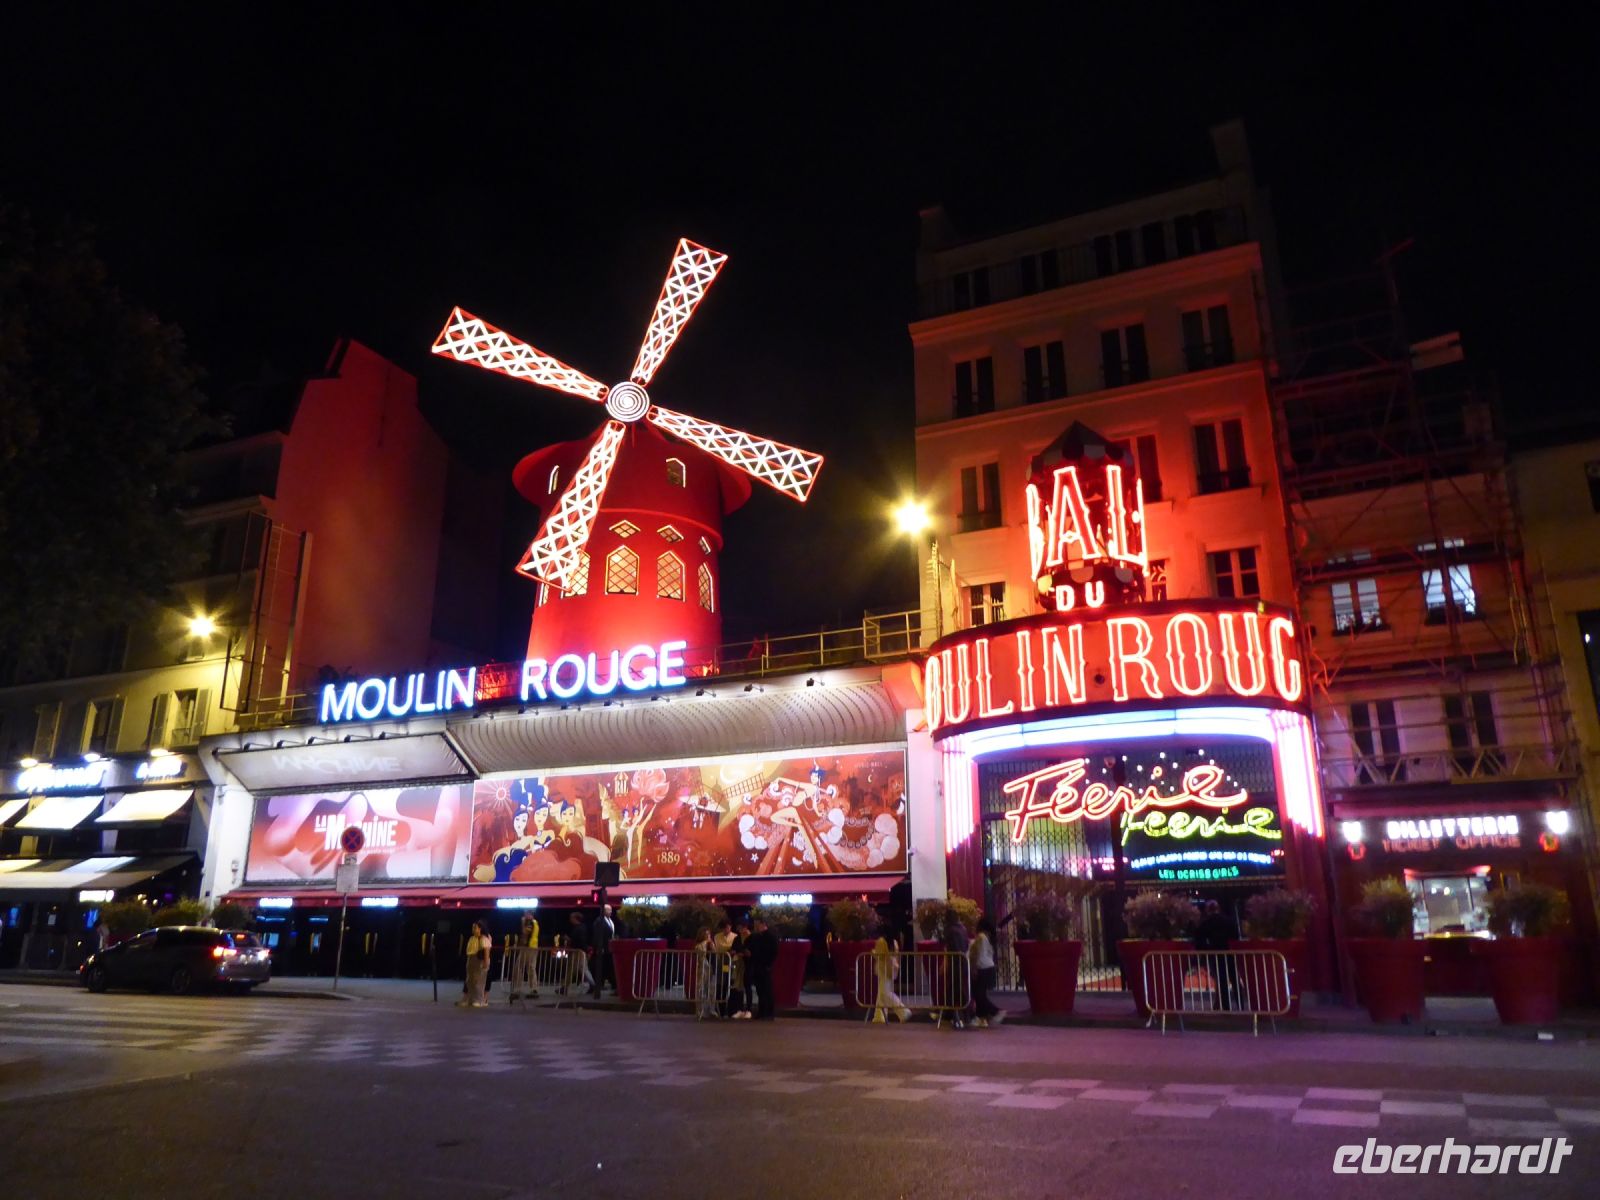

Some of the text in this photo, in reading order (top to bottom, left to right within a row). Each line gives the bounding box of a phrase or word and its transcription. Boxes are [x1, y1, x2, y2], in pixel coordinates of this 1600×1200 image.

[1055, 580, 1105, 612] DU
[320, 640, 687, 723] MOULIN ROUGE
[1386, 815, 1519, 840] BILLETTERIE
[657, 851, 681, 866] 1889
